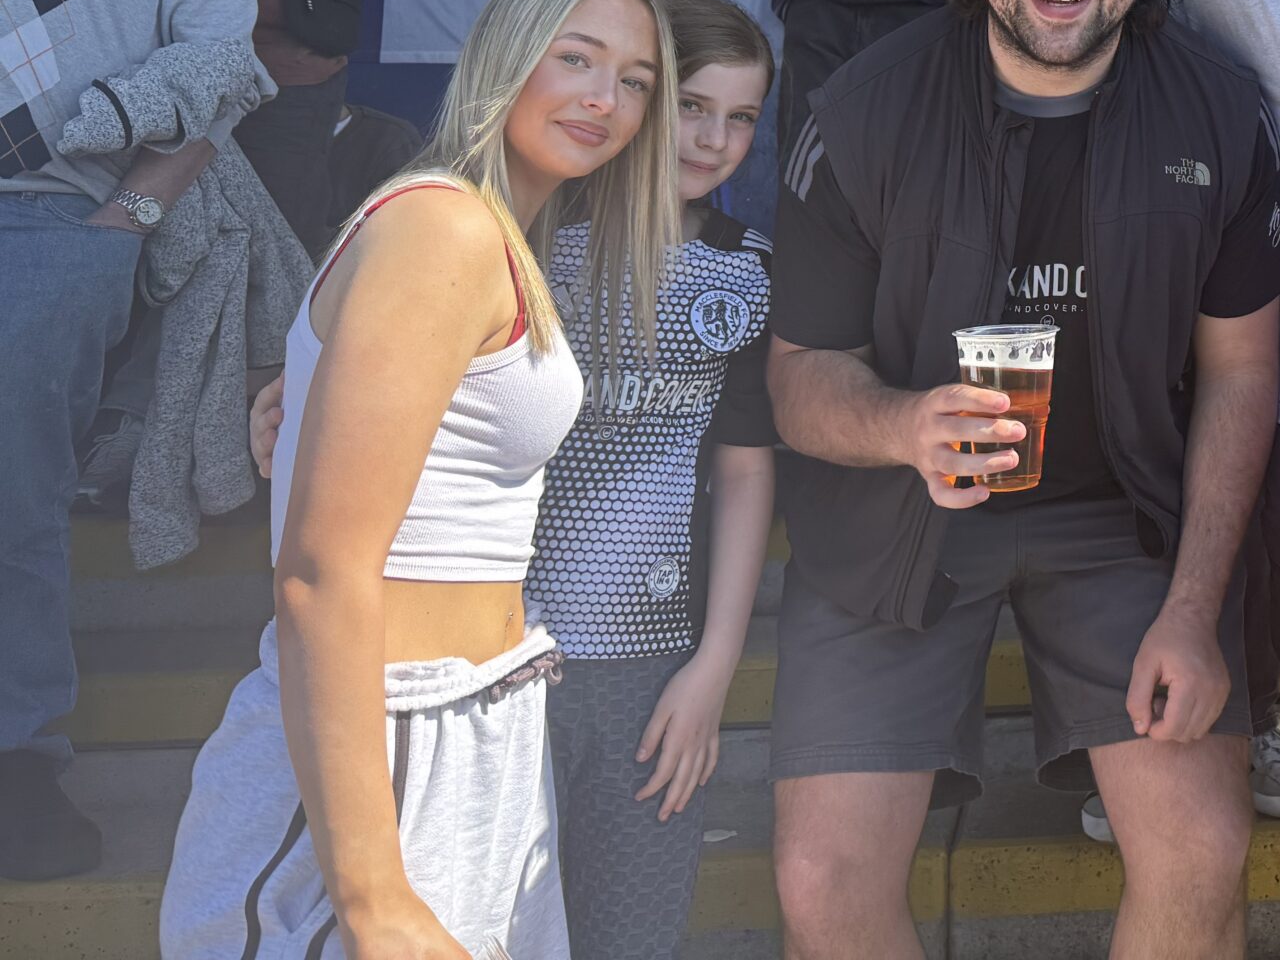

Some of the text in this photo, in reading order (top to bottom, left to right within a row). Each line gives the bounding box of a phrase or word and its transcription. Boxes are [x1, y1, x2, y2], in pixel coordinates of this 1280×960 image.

[1165, 165, 1195, 175] NORT
[642, 378, 712, 413] COVER
[658, 569, 673, 578] TAP
